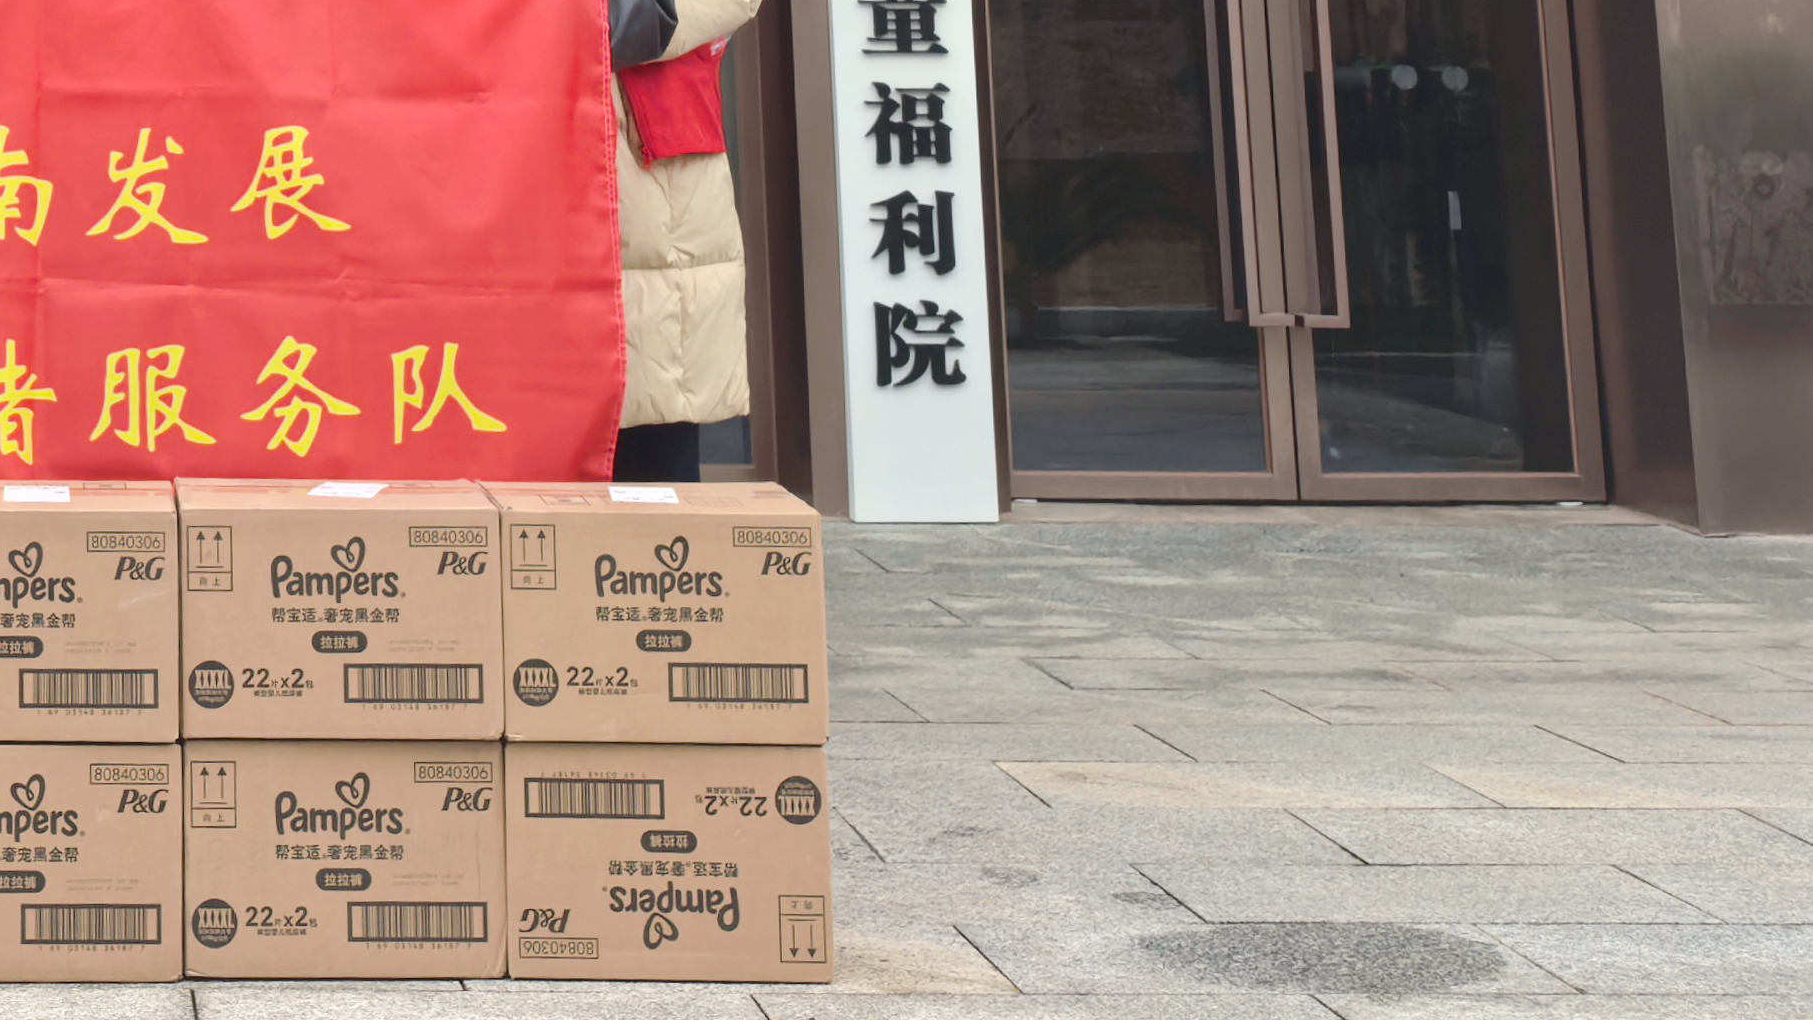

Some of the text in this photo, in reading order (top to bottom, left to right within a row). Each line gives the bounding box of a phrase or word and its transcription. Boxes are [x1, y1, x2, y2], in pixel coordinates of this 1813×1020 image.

[91, 535, 161, 549] 80840306
[414, 530, 483, 544] 80840306
[737, 530, 807, 544] 80840306
[114, 556, 165, 580] P&G
[437, 551, 488, 575] P&G
[761, 551, 812, 575] P&G
[271, 555, 399, 603] Pampers
[595, 554, 723, 603] Pampers
[194, 670, 231, 689] XXXXL
[519, 667, 556, 687] XXXXL
[94, 767, 164, 781] 80840306
[418, 765, 488, 779] 80840306
[117, 789, 169, 813] P&G
[442, 787, 493, 811] P&G
[275, 791, 404, 840] Pampers
[198, 908, 234, 928] XXXXL
[609, 880, 739, 932] Pampers
[518, 908, 570, 933] P&G
[523, 940, 594, 955] 80840306
